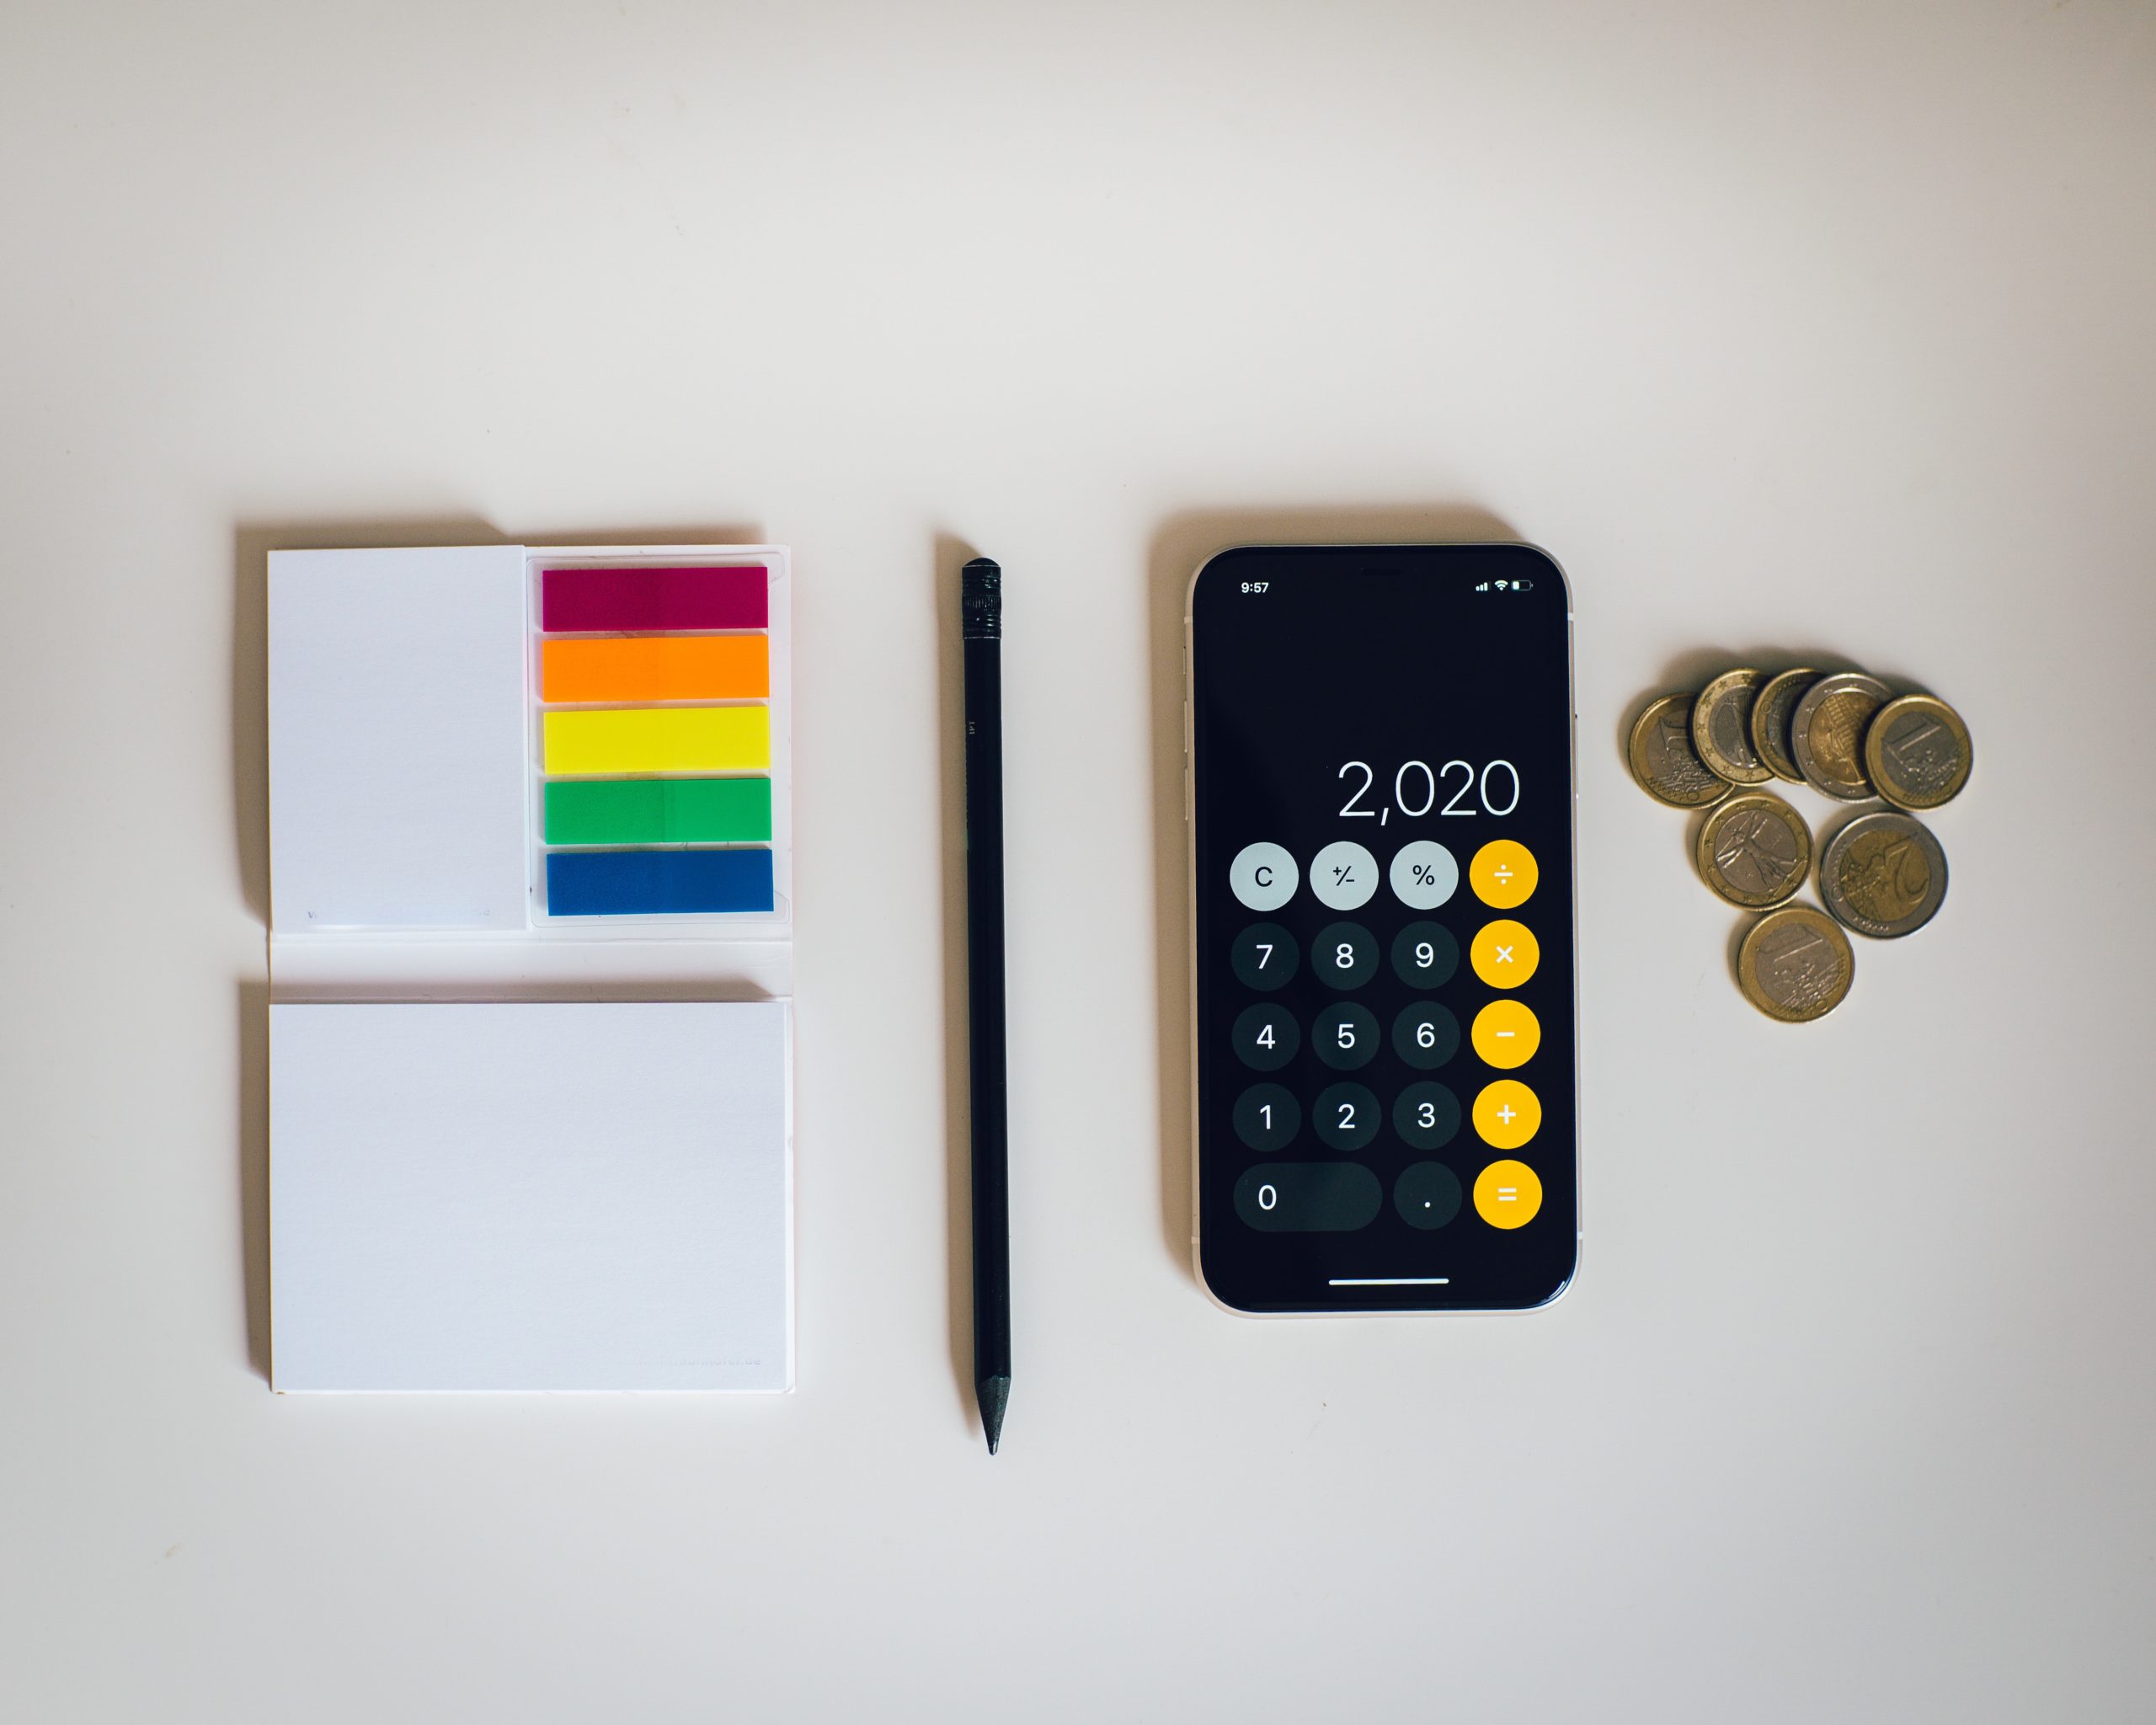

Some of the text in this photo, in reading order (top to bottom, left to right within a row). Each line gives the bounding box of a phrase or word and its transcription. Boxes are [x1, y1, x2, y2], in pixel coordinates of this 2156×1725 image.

[1241, 581, 1269, 594] 9:57
[1338, 759, 1520, 826] 2,020
[1255, 866, 1273, 888] C
[1412, 864, 1435, 886] %
[1256, 944, 1273, 969] 7
[1336, 943, 1354, 969] 8
[1415, 942, 1434, 969] 9
[1256, 1024, 1276, 1049] 4
[1337, 1023, 1356, 1049] 5
[1417, 1022, 1435, 1049] 6
[1259, 1104, 1271, 1130] 1
[1338, 1103, 1356, 1129] 2
[1417, 1103, 1436, 1129] 3
[1258, 1184, 1277, 1210] 0
